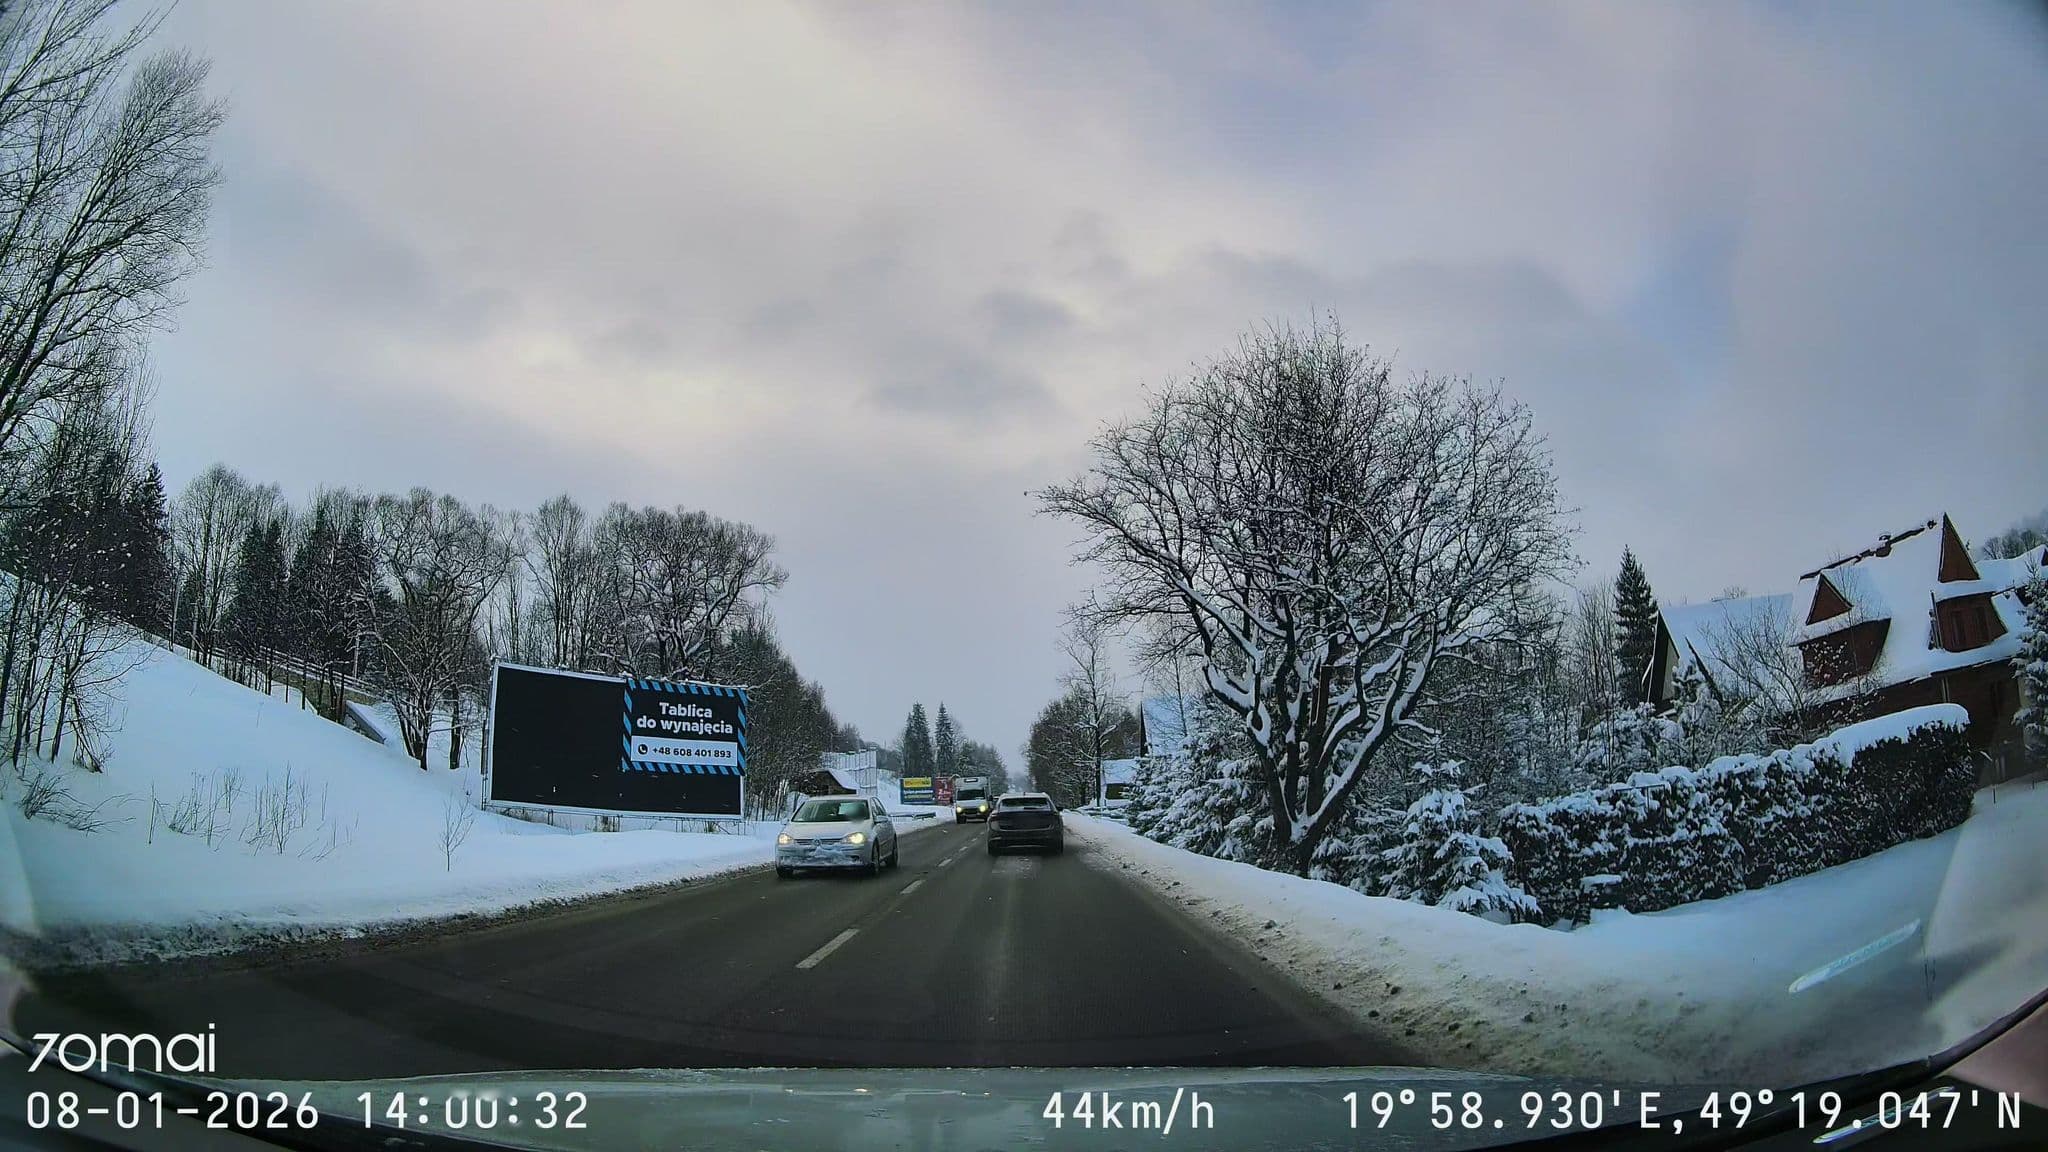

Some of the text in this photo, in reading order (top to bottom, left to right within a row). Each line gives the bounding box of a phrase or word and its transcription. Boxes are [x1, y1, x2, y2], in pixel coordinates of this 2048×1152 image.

[659, 702, 713, 718] Tablica
[636, 715, 733, 735] do wynajęcia
[652, 746, 732, 759] +48 608 401 893
